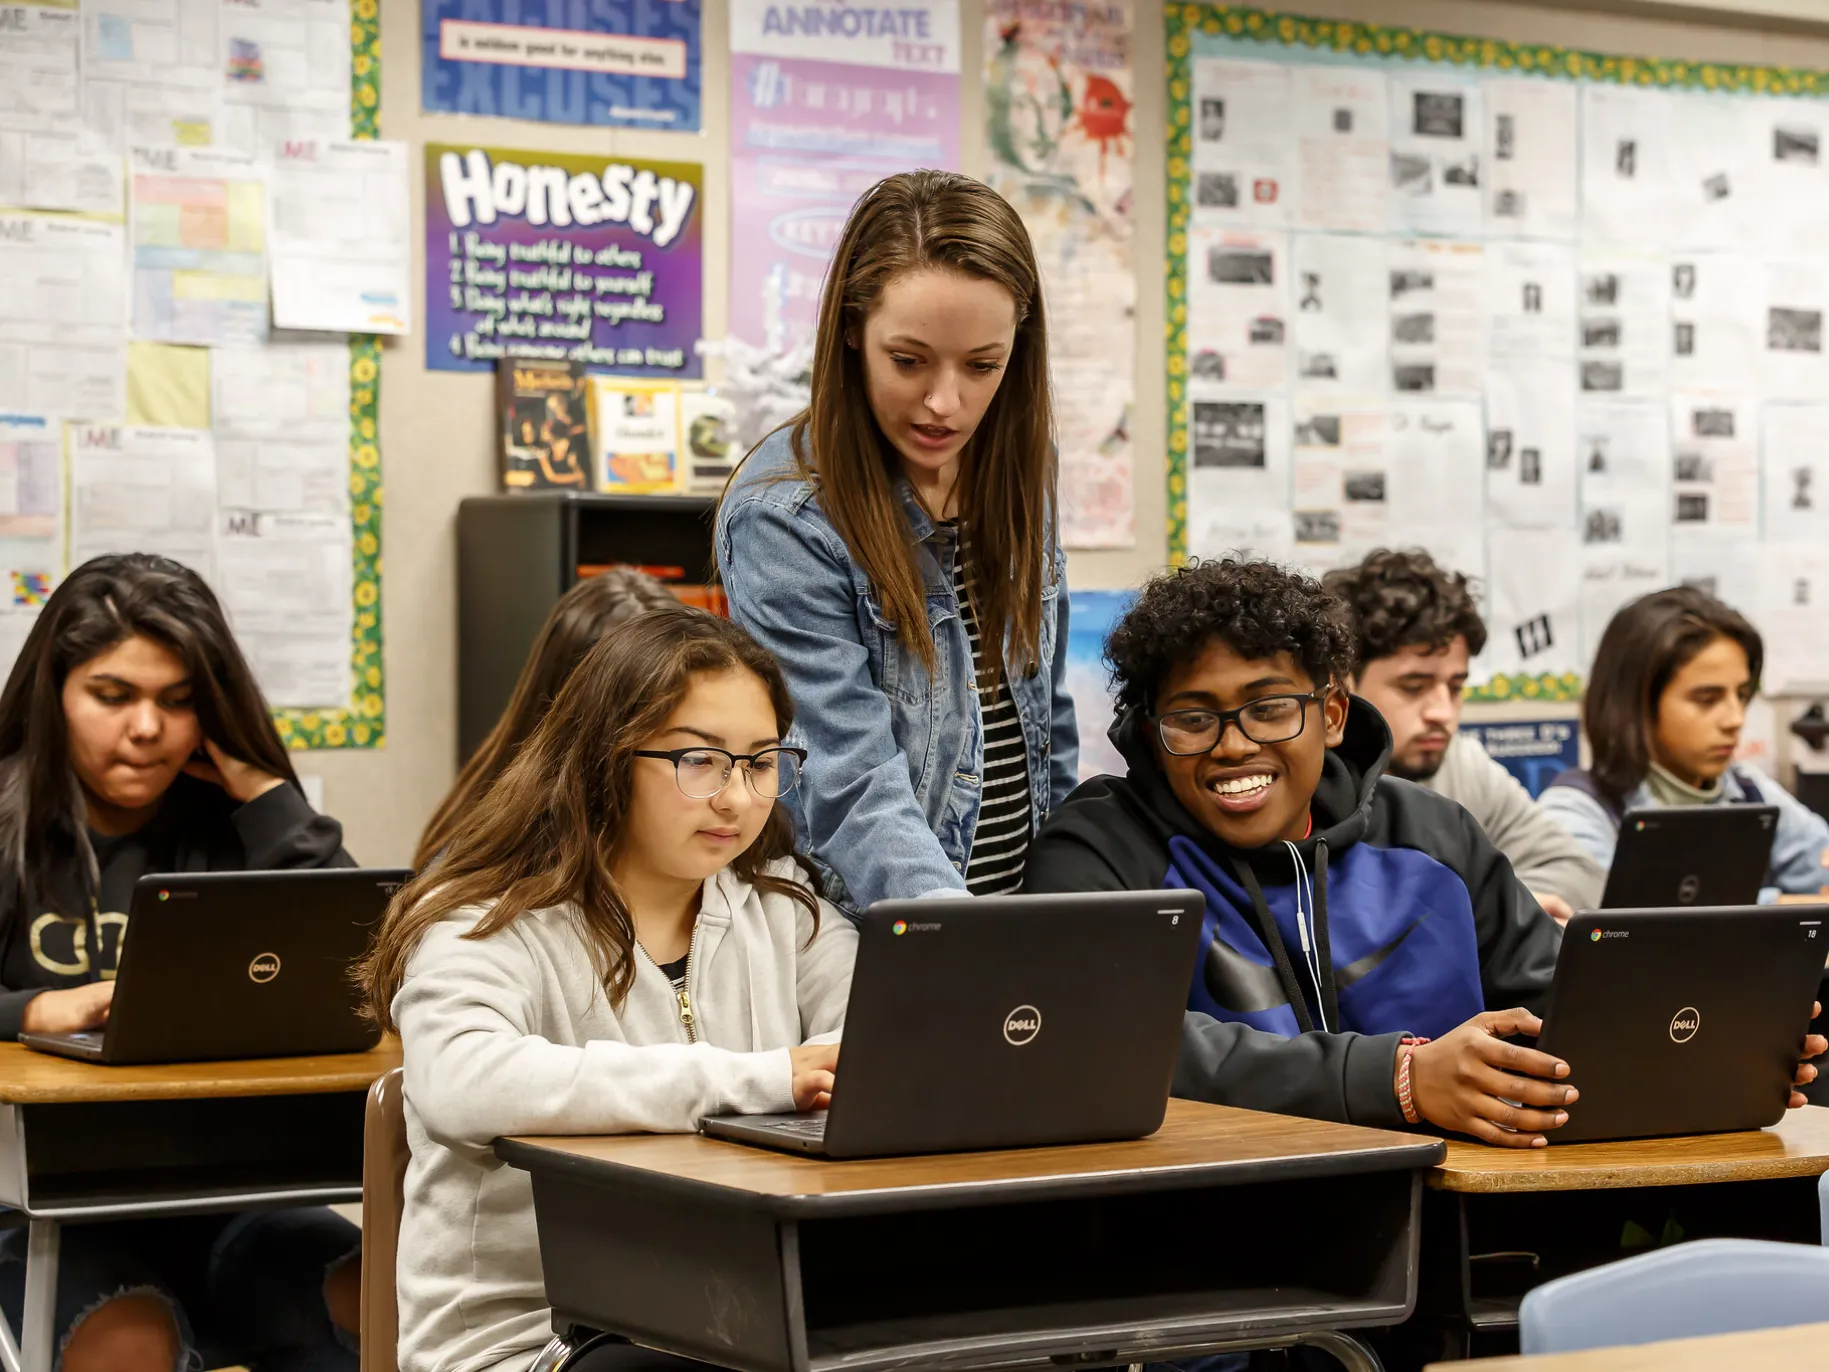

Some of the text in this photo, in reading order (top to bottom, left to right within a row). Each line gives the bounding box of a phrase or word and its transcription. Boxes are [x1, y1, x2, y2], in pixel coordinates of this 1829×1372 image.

[761, 6, 931, 38] ANNOTATE
[892, 41, 949, 66] TEXT
[440, 149, 694, 247] Honesty
[509, 239, 571, 264] truthful
[573, 244, 594, 264] to
[594, 243, 642, 269] others
[509, 266, 571, 291] truthful
[573, 271, 594, 291] to
[594, 270, 654, 297] yourself
[475, 314, 495, 337] of
[568, 340, 616, 365] others
[617, 347, 644, 365] can
[645, 346, 684, 367] trust
[908, 921, 942, 932] chrome
[1171, 915, 1179, 925] 8
[1602, 930, 1630, 939] chrome
[1807, 929, 1817, 939] 18
[252, 963, 277, 972] DELL
[1008, 1019, 1037, 1031] DELL
[1673, 1019, 1696, 1031] DELL
